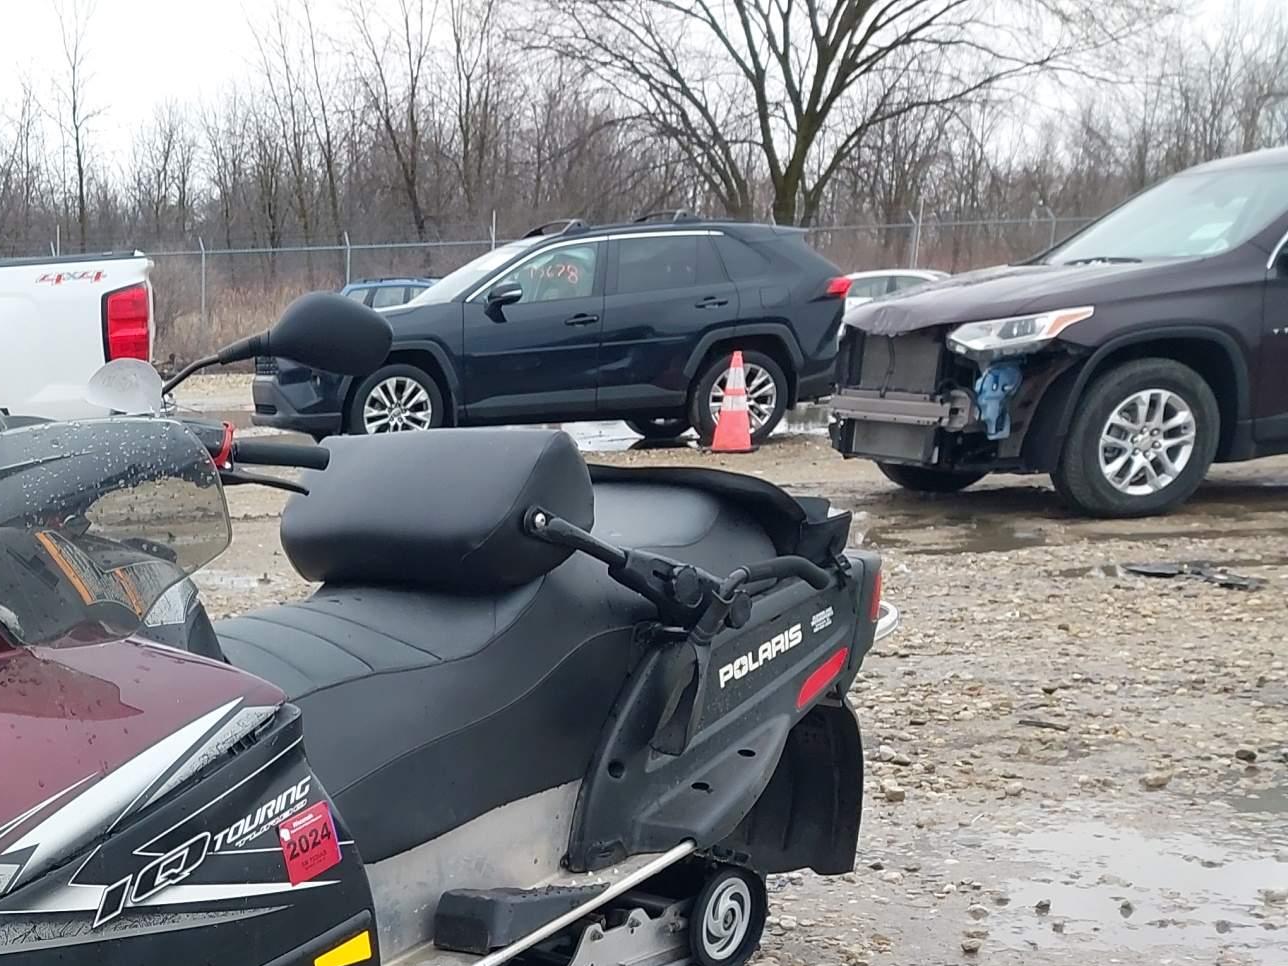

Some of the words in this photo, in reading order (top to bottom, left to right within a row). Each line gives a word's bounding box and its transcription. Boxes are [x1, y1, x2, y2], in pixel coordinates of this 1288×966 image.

[718, 623, 803, 689] POLARIS
[214, 775, 312, 852] TOURING
[287, 822, 332, 862] 2024
